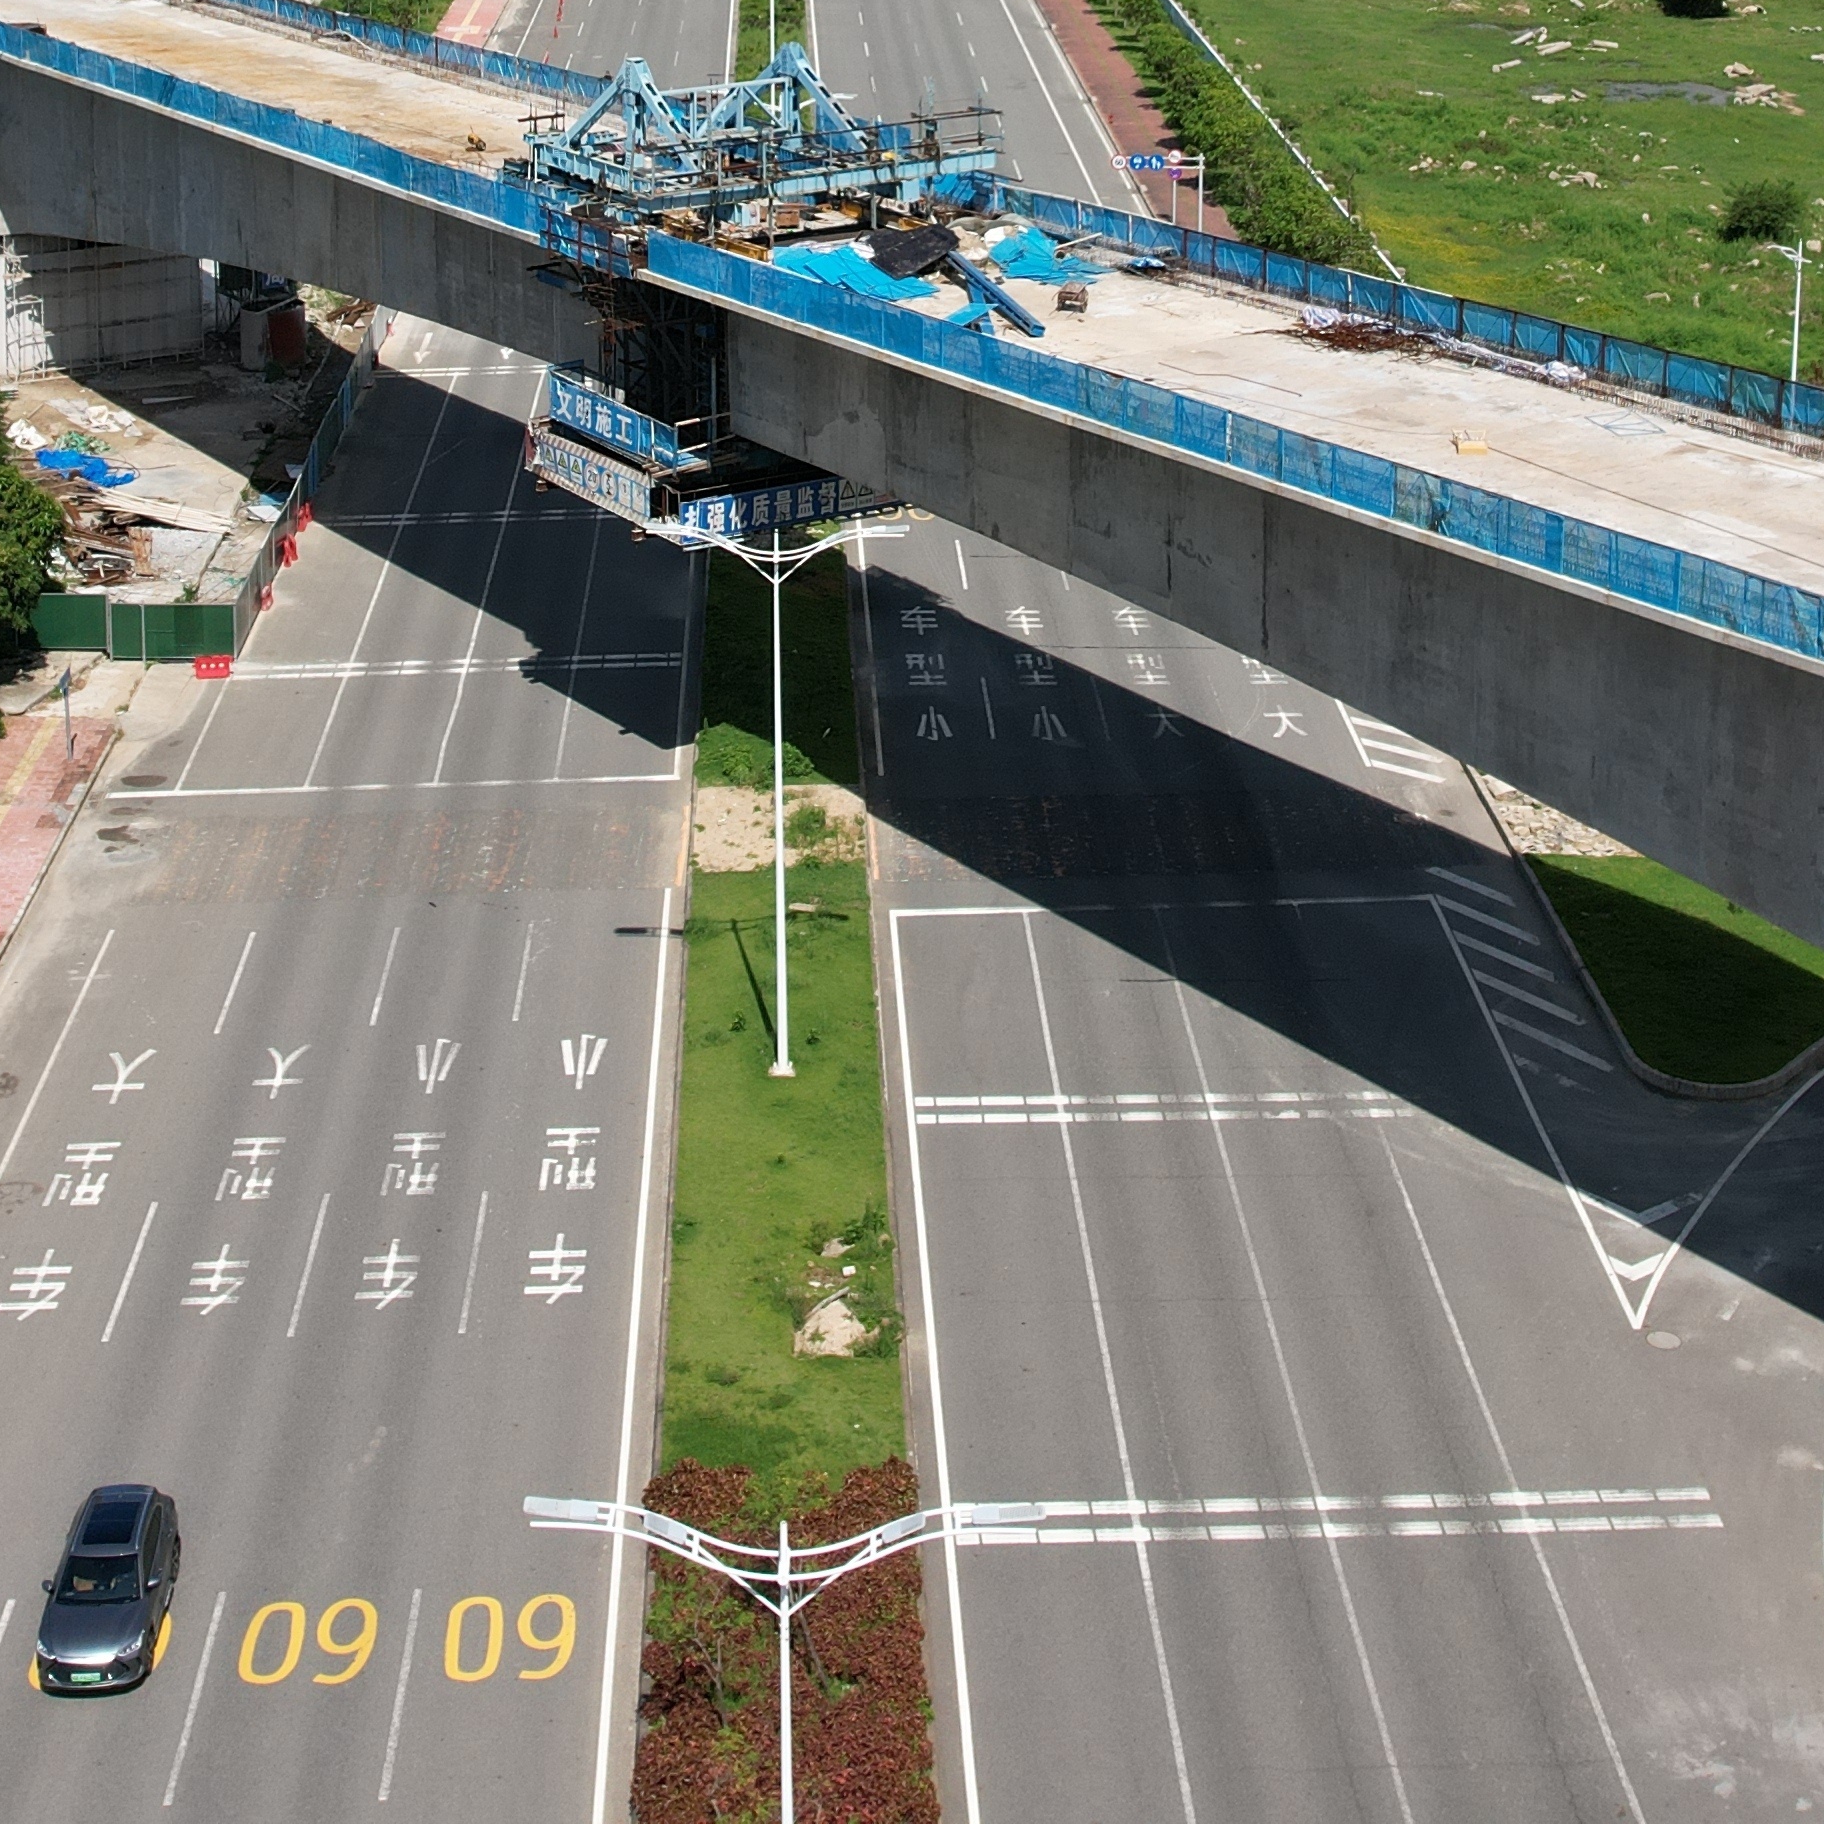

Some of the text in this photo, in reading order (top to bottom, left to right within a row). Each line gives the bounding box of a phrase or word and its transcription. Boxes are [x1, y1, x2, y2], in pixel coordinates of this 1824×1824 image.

[555, 388, 633, 446] 文明施工
[706, 481, 838, 534] 强化质量监督
